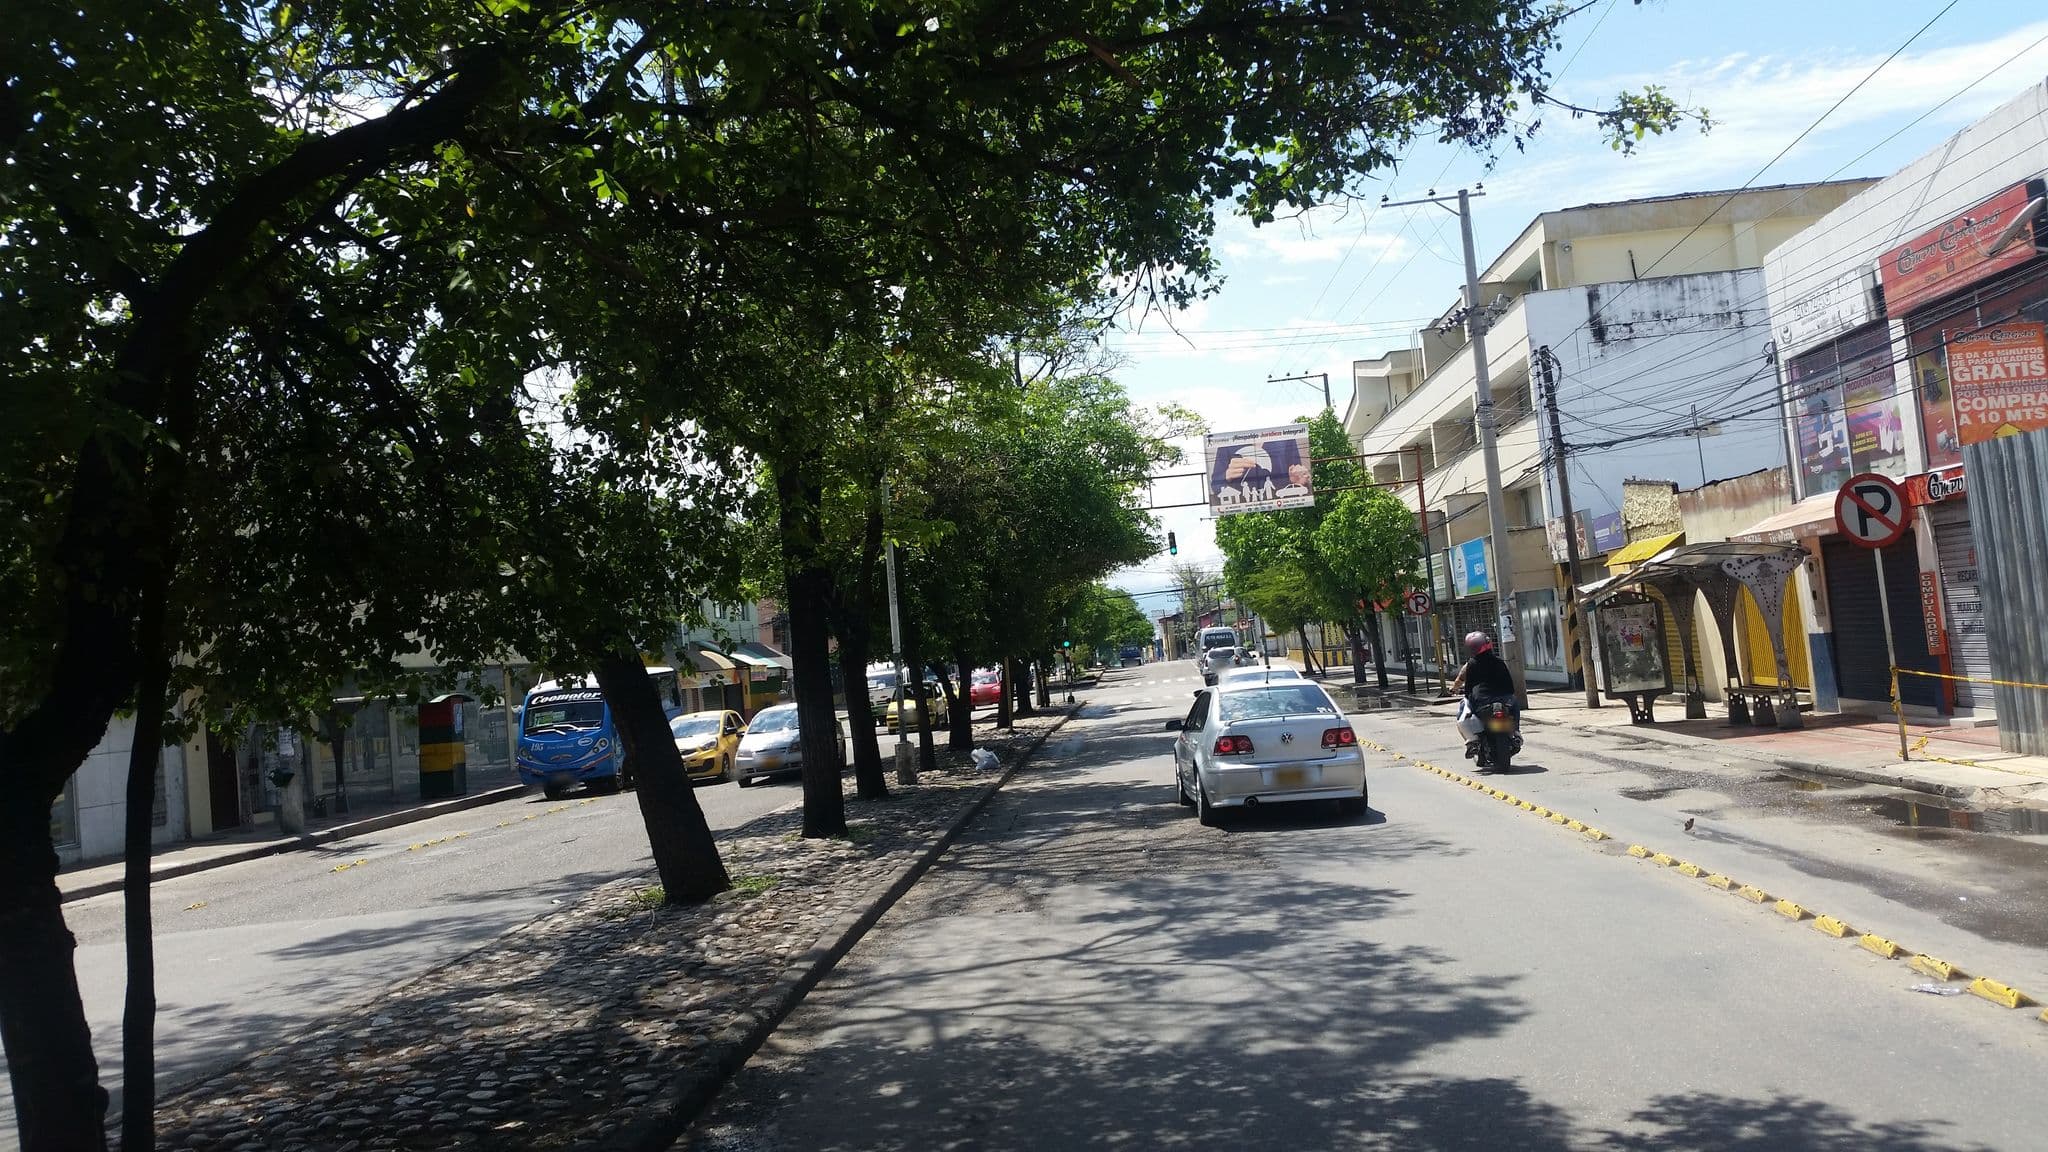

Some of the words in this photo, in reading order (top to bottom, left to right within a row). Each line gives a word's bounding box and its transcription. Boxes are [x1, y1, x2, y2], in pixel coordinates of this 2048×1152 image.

[1966, 351, 1980, 359] DA
[1982, 350, 1995, 358] 15
[1996, 346, 2044, 357] MINUTOS
[1968, 353, 2045, 366] PARQUEADERO
[1953, 360, 2047, 382] GRATIS
[1954, 383, 1979, 392] PARA
[1982, 381, 1996, 389] SU
[1956, 389, 1979, 399] POR
[1982, 384, 2048, 396] CUALQUIER
[1956, 391, 2048, 412] COMPRA
[1959, 413, 1972, 426] A
[1978, 411, 2001, 424] 10
[1855, 485, 1892, 537] P
[1921, 574, 1940, 648] COMPUTADORES
[531, 691, 602, 705] Coomotor
